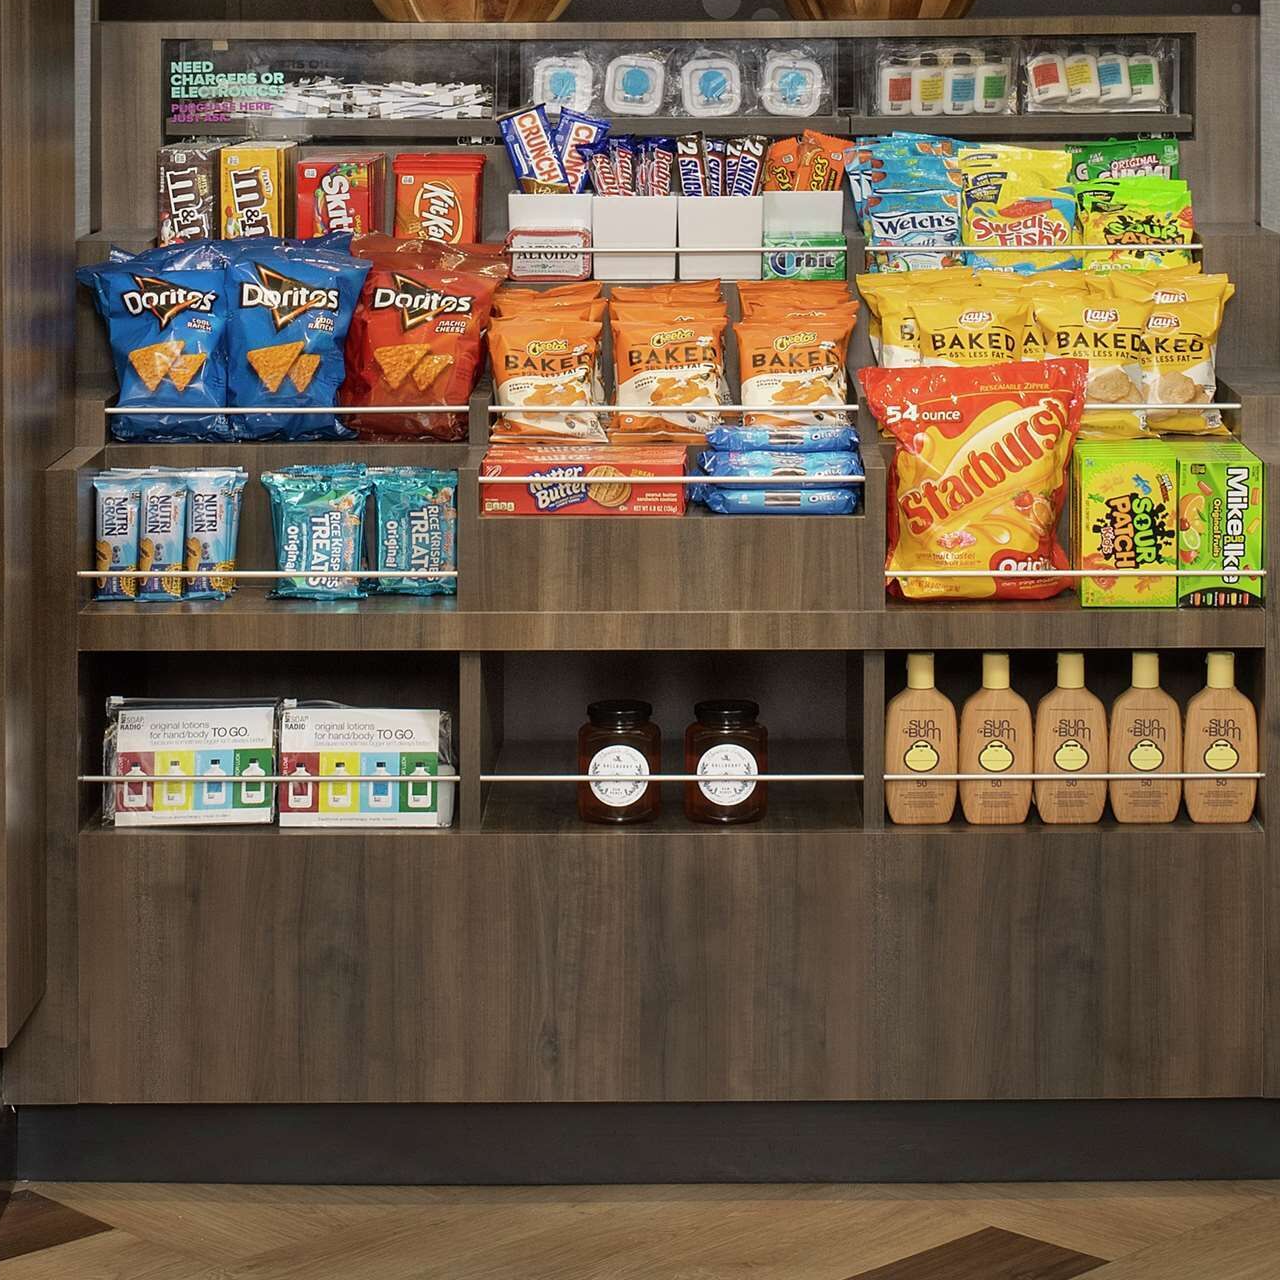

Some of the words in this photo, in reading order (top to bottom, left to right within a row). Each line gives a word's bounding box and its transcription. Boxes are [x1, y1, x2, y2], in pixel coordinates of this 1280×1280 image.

[170, 61, 214, 73] NEED
[170, 73, 257, 86] CHARGERS
[260, 72, 285, 84] OR
[514, 112, 561, 184] CRUNCH
[877, 215, 956, 235] Welch's
[972, 215, 1069, 243] Swedish
[123, 292, 217, 315] Doritos
[242, 283, 338, 310] Doritos
[373, 288, 472, 313] Doritos
[1086, 309, 1118, 324] Lay's
[435, 326, 465, 334] CHEESE
[651, 329, 695, 348] Cheetos
[528, 340, 568, 356] Cheetos
[773, 332, 817, 352] Cheetos
[931, 332, 1015, 352] BAKED
[1057, 331, 1141, 352] BAKED
[628, 346, 718, 366] BAKED
[969, 351, 988, 359] LESS
[1093, 350, 1112, 358] LESS
[1156, 355, 1174, 363] LESS
[886, 402, 919, 424] 54
[922, 410, 961, 421] ounce
[898, 398, 1069, 536] Starburst
[537, 482, 588, 509] Butter
[1226, 467, 1249, 536] Mike
[104, 497, 117, 536] GRAIN
[115, 497, 128, 536] NUTRI
[148, 495, 160, 534] GRAIN
[159, 495, 172, 533] NUTRI
[193, 493, 206, 533] GRAIN
[204, 494, 218, 532] NUTRI
[1109, 495, 1136, 568] PATCH
[1132, 496, 1157, 564] SOUR
[150, 721, 180, 731] original
[182, 720, 209, 729] lotions
[163, 730, 209, 740] hand/body
[211, 727, 227, 737] TO
[229, 726, 249, 737] GO.
[315, 722, 345, 731] original
[347, 721, 375, 730] lotions
[376, 729, 393, 740] TO
[395, 729, 416, 740] GO.
[328, 732, 374, 741] hand/body
